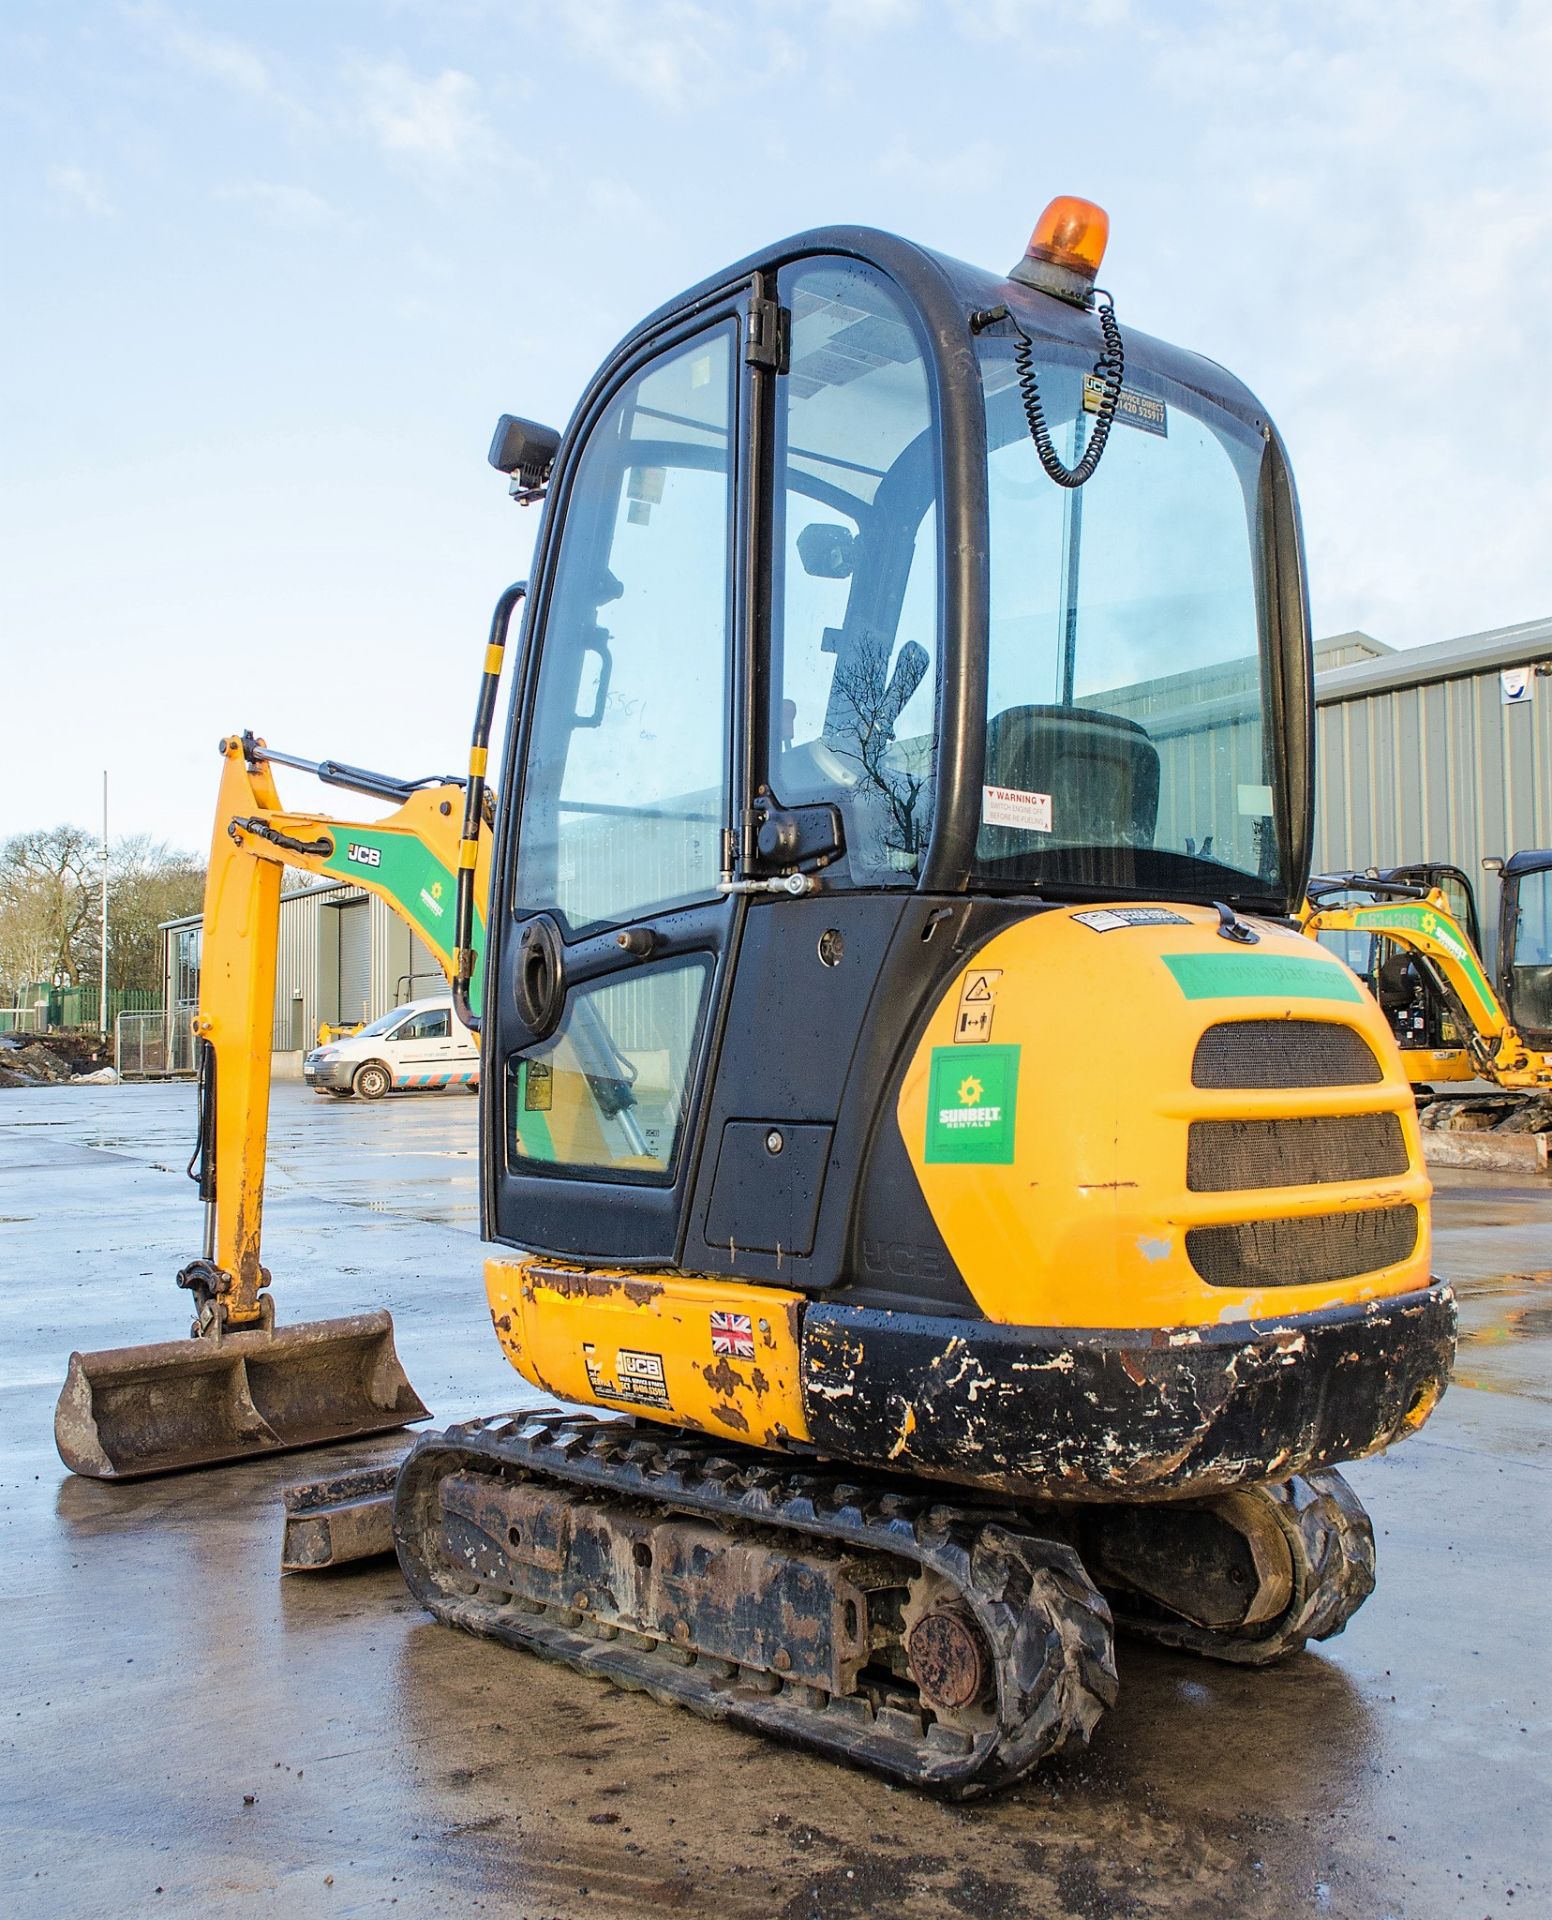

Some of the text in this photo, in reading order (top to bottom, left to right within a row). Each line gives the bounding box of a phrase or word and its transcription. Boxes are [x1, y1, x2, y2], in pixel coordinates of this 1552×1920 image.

[1141, 399, 1164, 412] DIRECT
[996, 791, 1037, 805] WARNING
[348, 843, 381, 867] JCB
[939, 1107, 1001, 1124] SUNBELT
[946, 1121, 991, 1129] RENTALS
[626, 1357, 659, 1376] JCB
